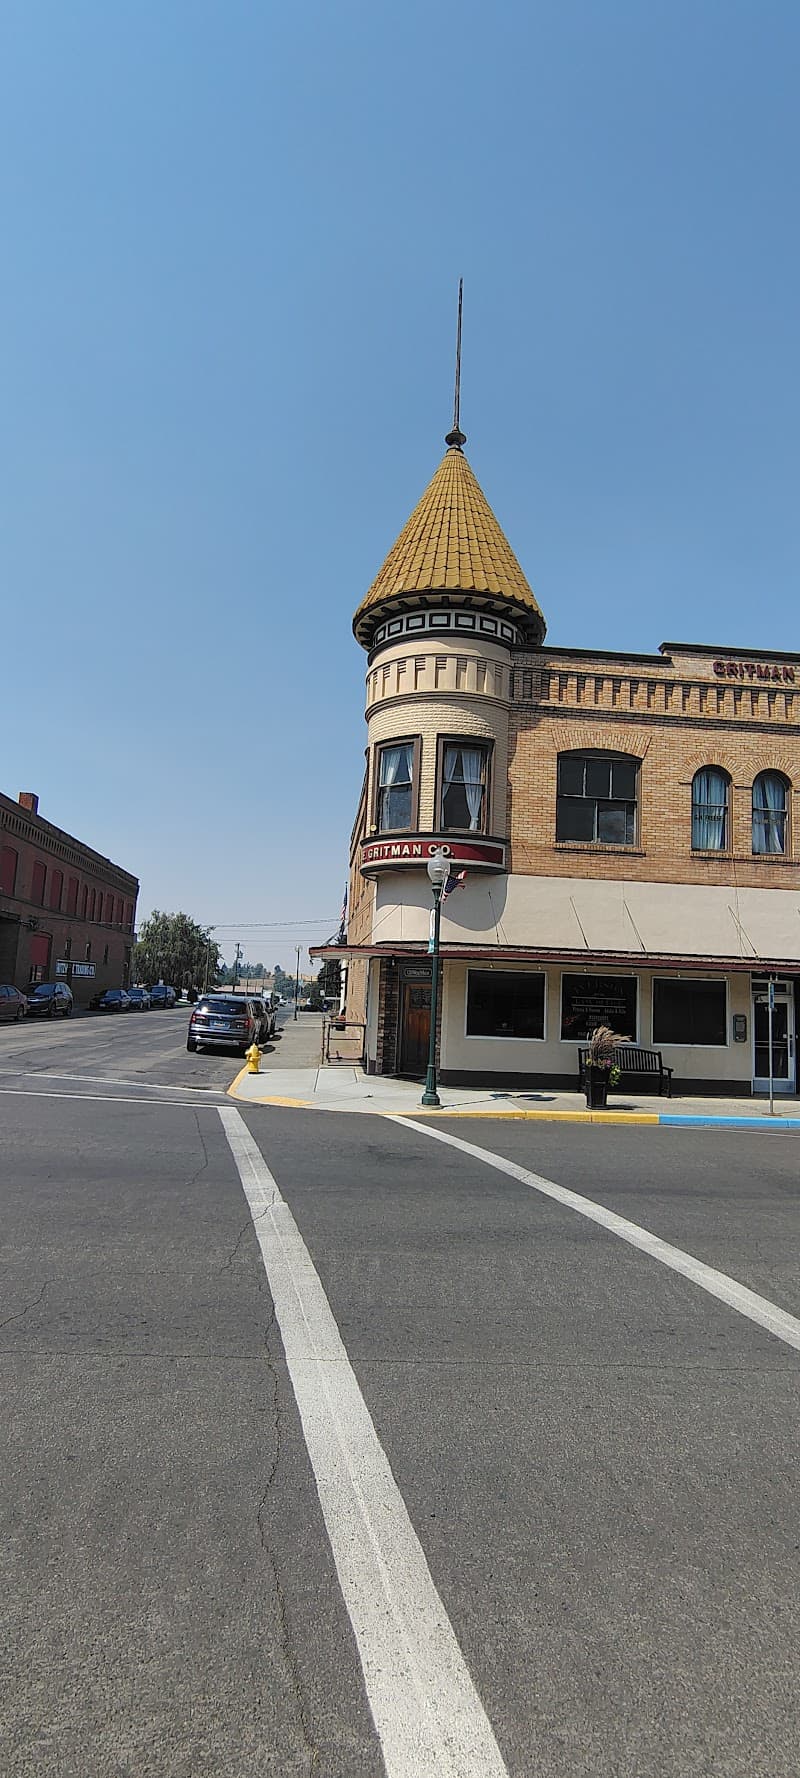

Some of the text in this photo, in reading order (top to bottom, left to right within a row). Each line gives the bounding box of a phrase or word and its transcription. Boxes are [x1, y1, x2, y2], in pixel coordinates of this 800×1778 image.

[712, 660, 795, 682] GRITMAN
[368, 844, 422, 859] GRITMAN
[428, 844, 455, 856] CO.
